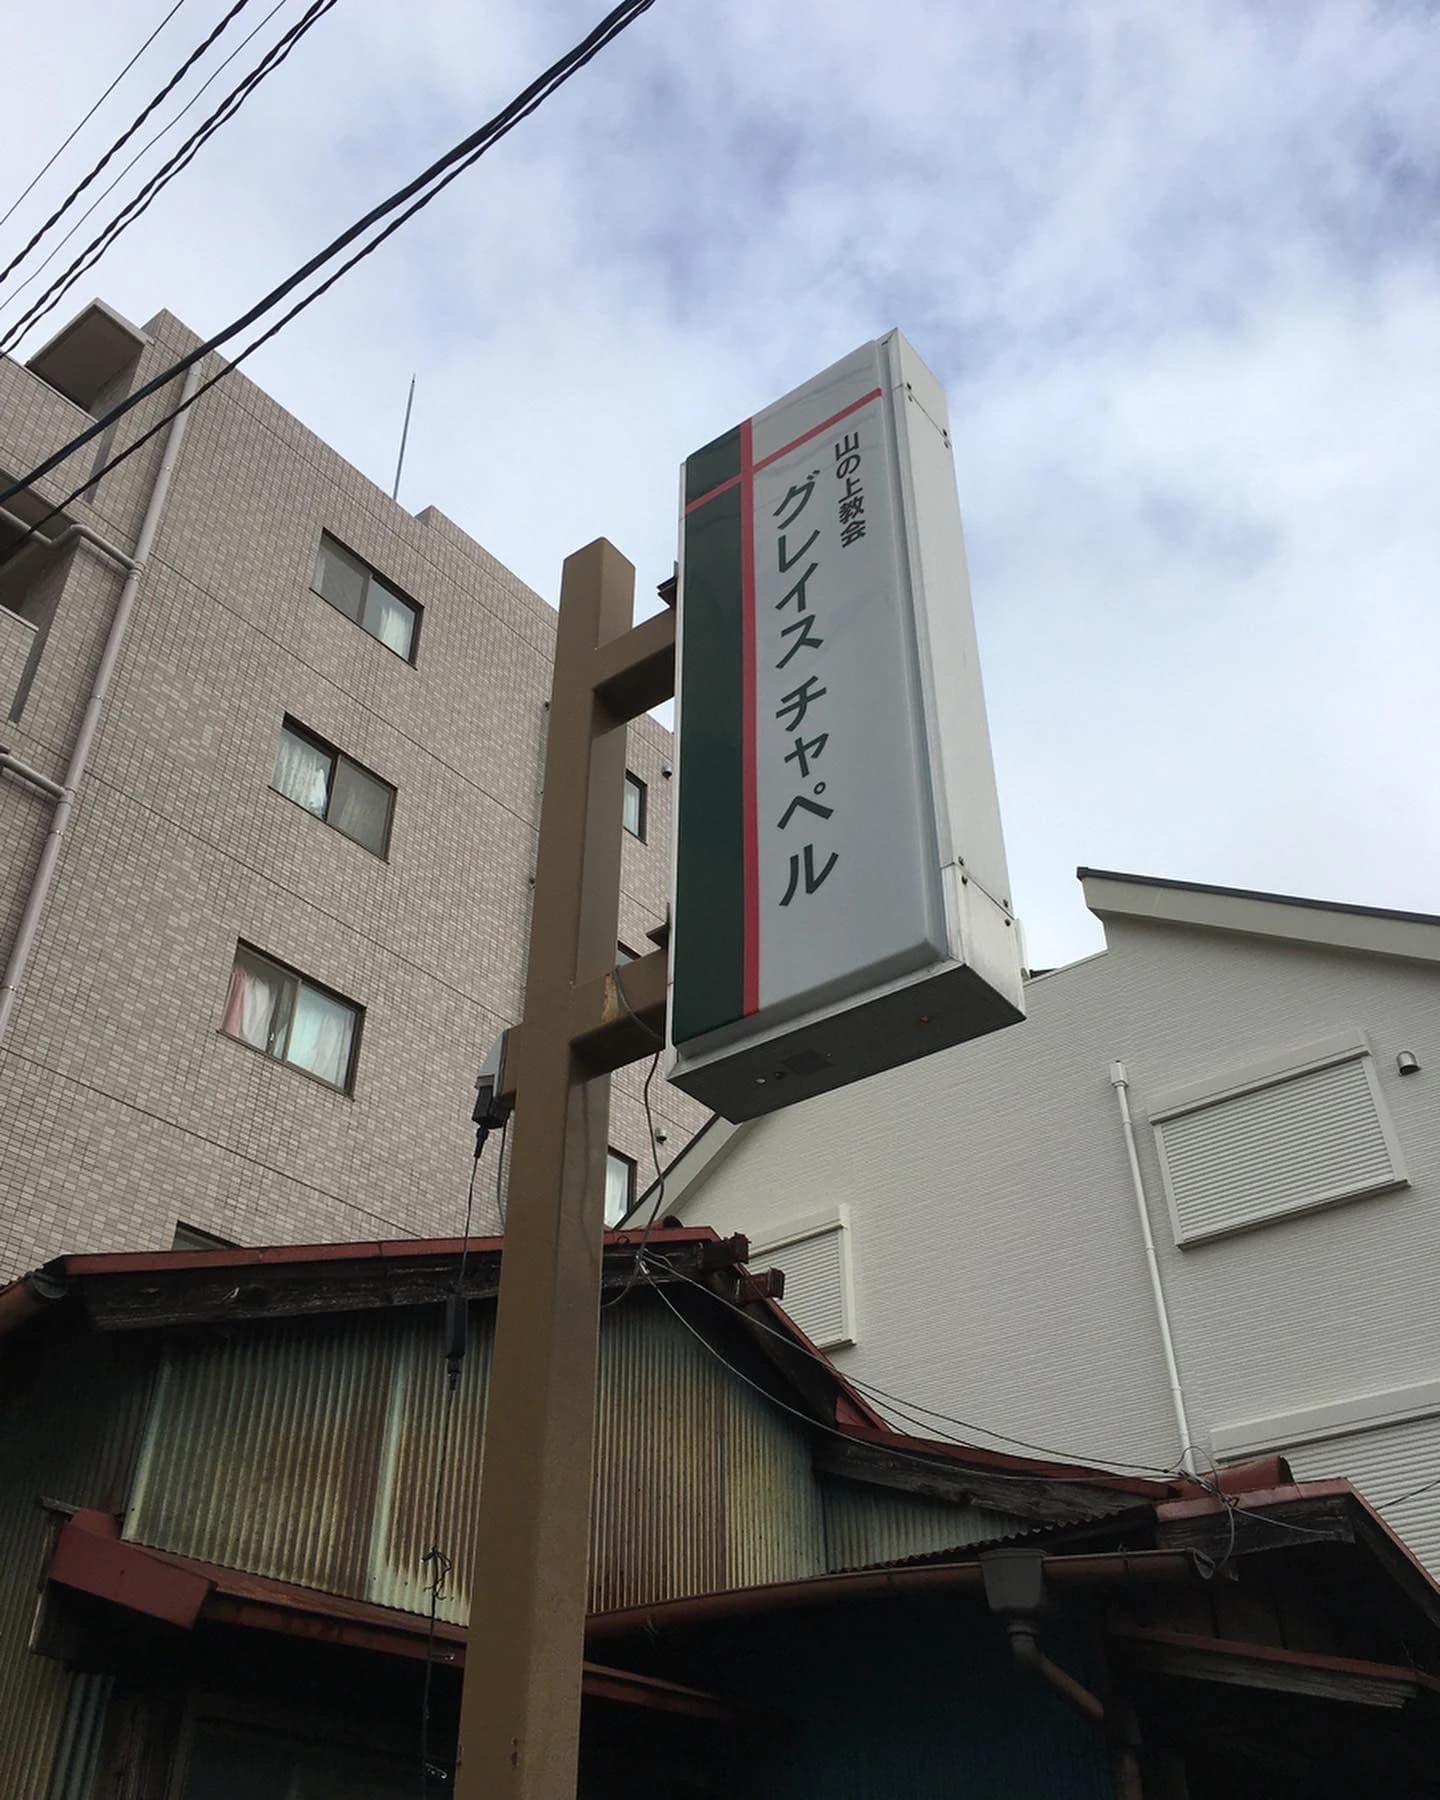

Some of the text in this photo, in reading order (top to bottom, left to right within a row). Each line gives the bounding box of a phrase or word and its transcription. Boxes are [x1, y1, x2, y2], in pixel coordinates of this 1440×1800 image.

[835, 432, 866, 548] 山の上教会
[773, 470, 839, 906] グレイスチャペル
